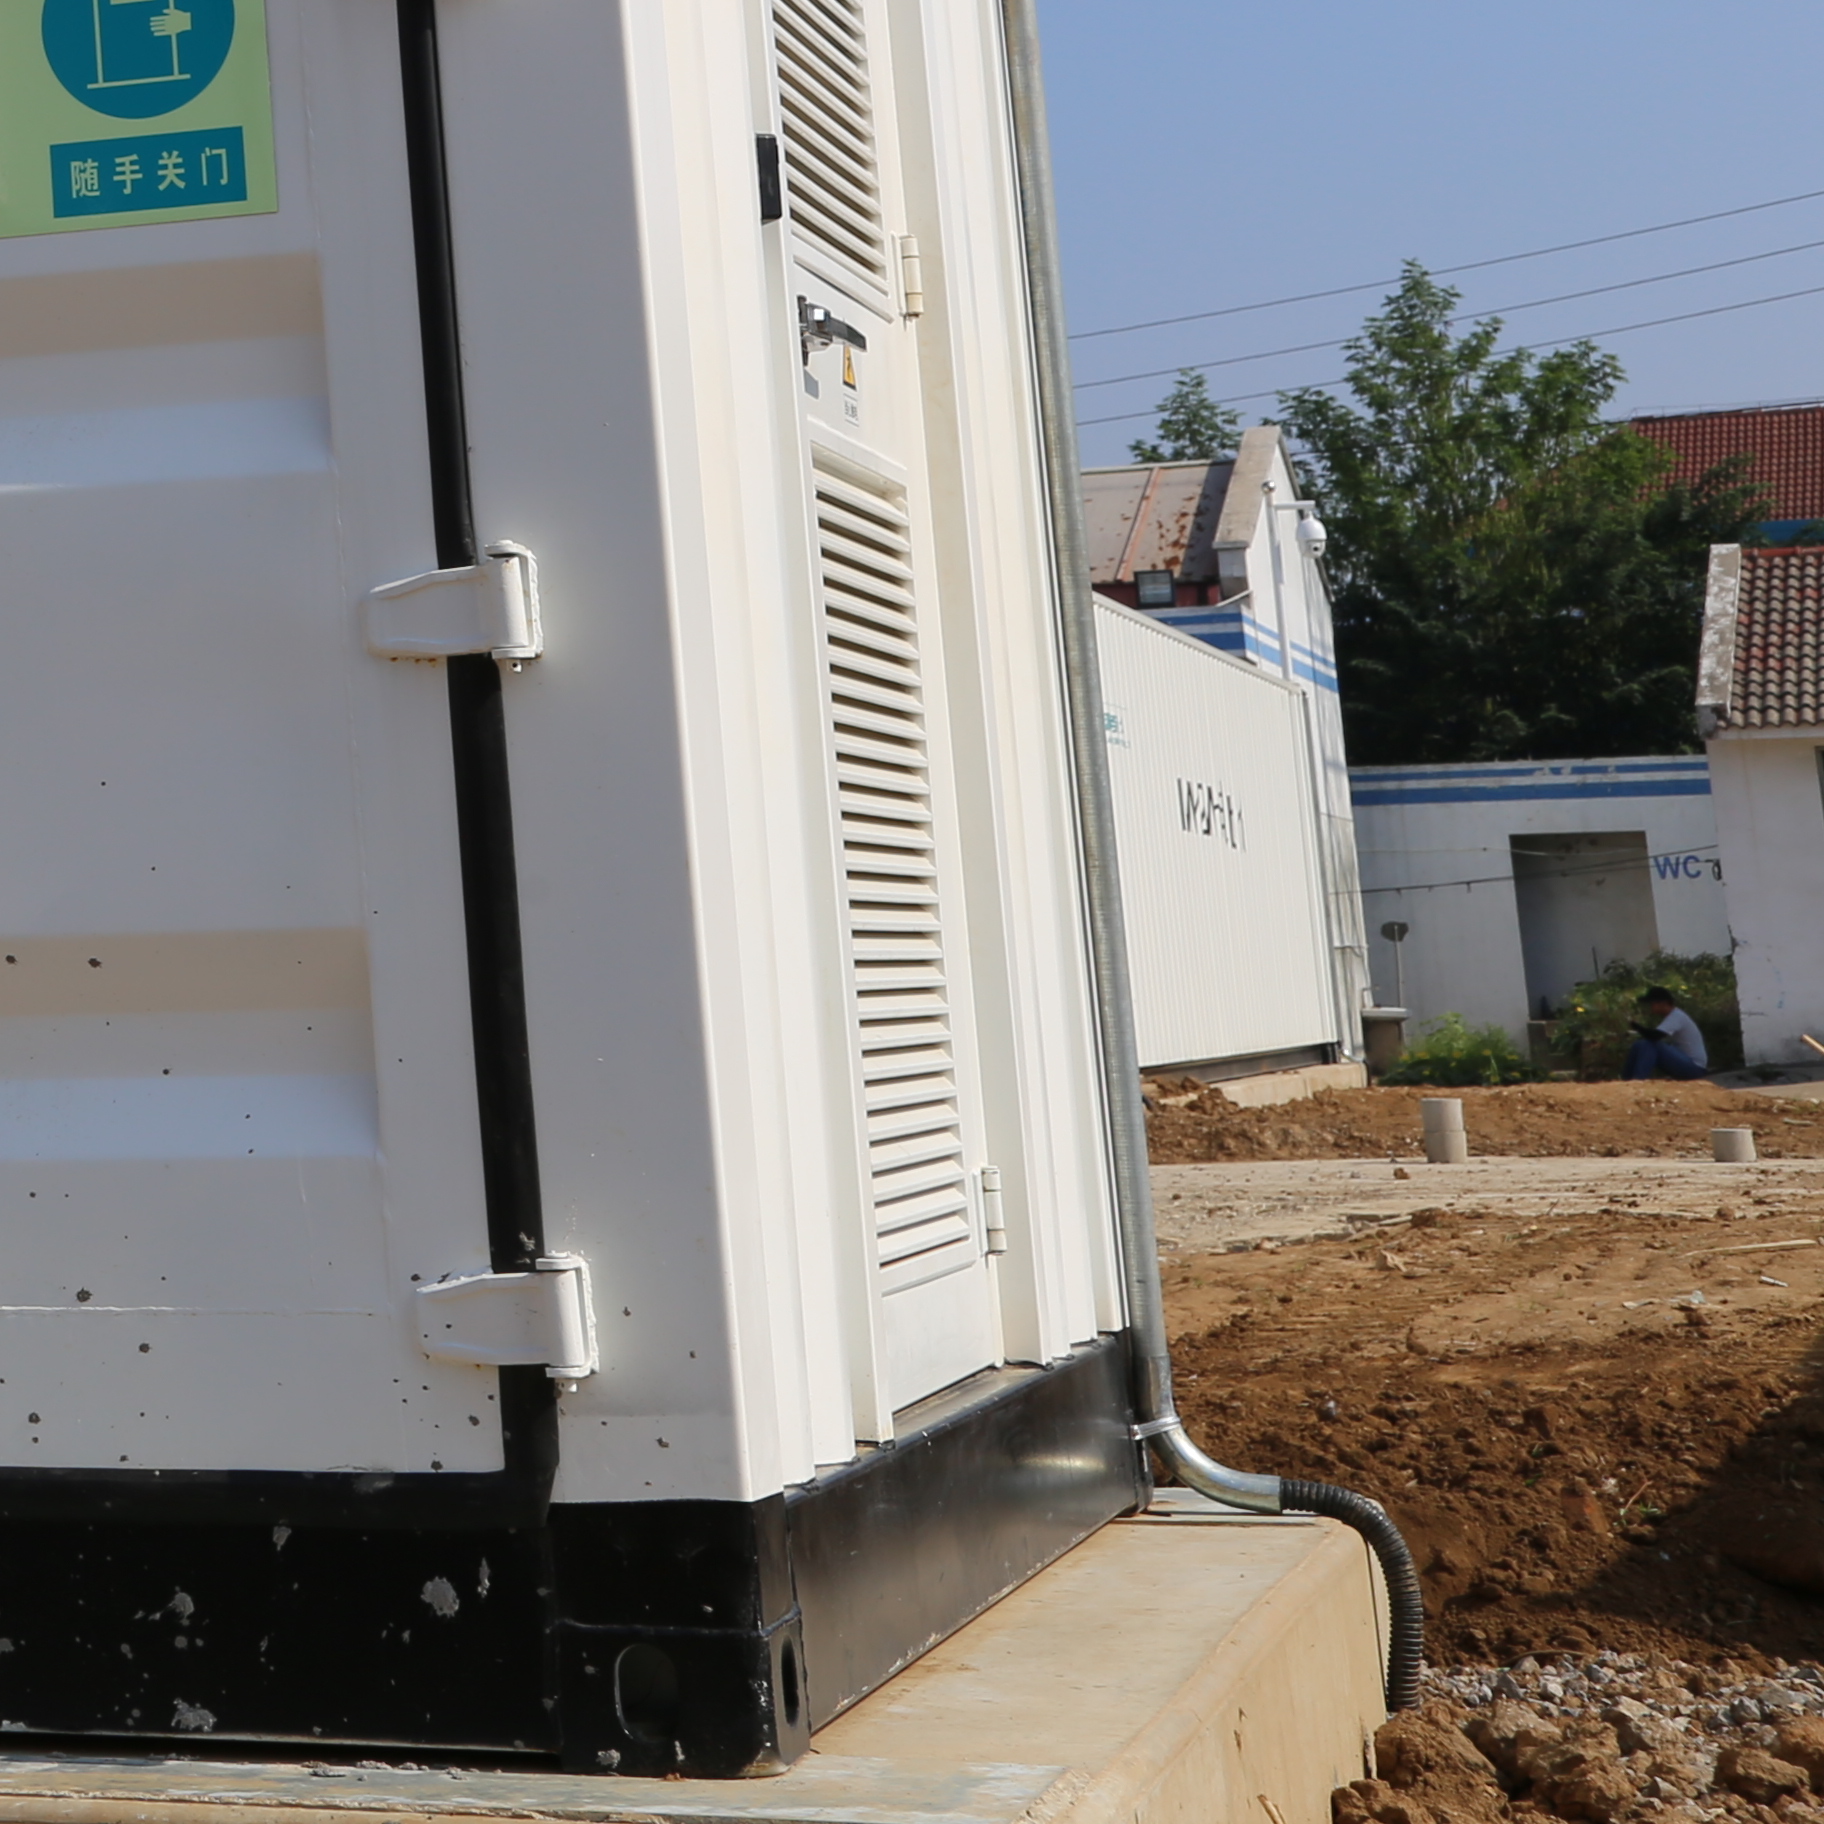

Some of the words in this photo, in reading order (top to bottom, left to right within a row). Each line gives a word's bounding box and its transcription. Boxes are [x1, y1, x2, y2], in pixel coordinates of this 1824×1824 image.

[70, 147, 230, 199] 随手关门
[1654, 855, 1702, 880] WC
